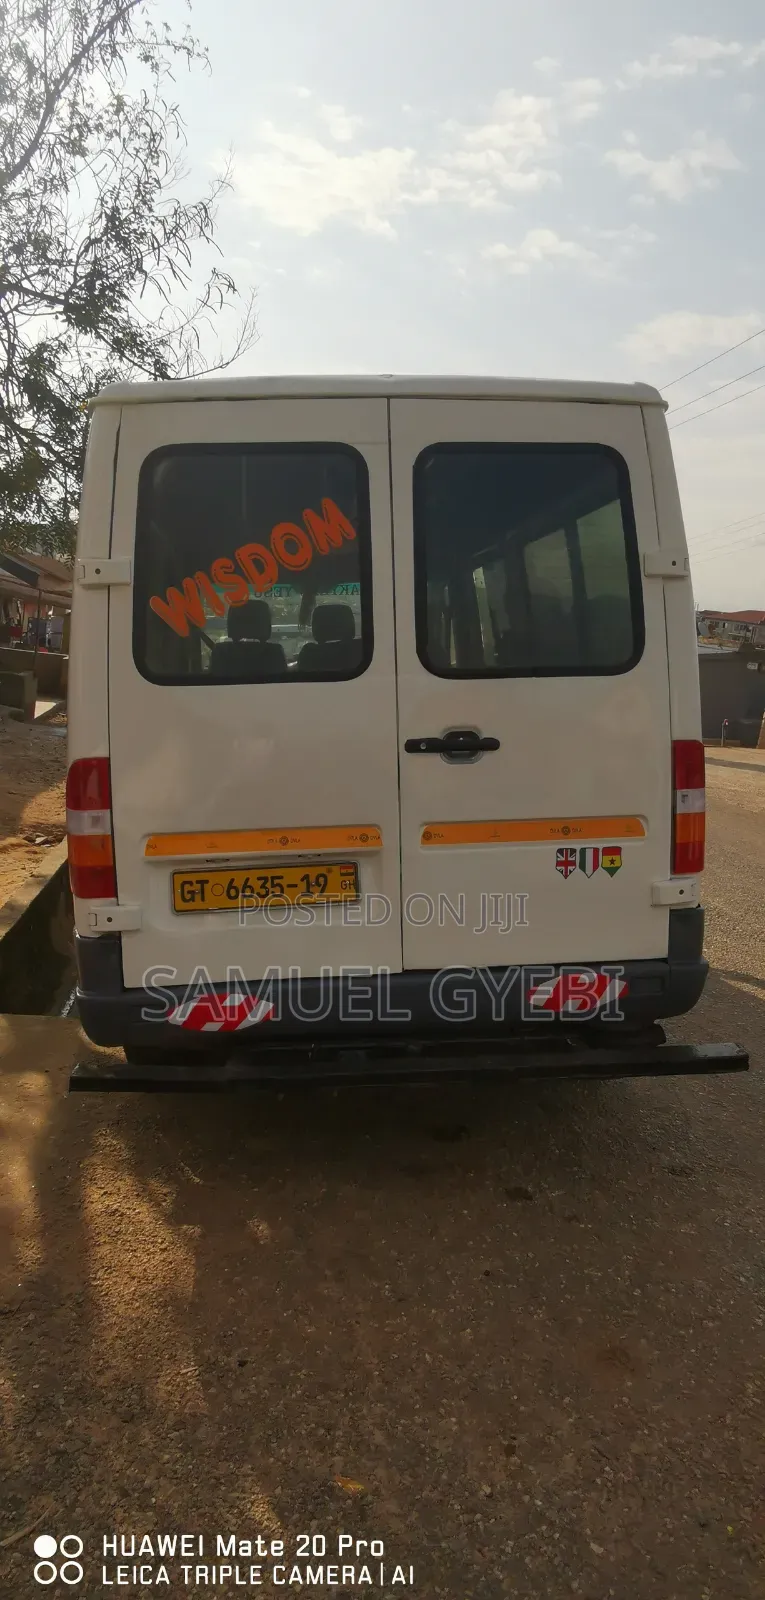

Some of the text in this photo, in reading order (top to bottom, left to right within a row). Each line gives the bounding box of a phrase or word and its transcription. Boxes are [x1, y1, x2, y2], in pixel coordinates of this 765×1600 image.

[150, 497, 356, 637] WISDOM
[180, 873, 328, 903] GT 6635-19
[340, 879, 355, 890] GH
